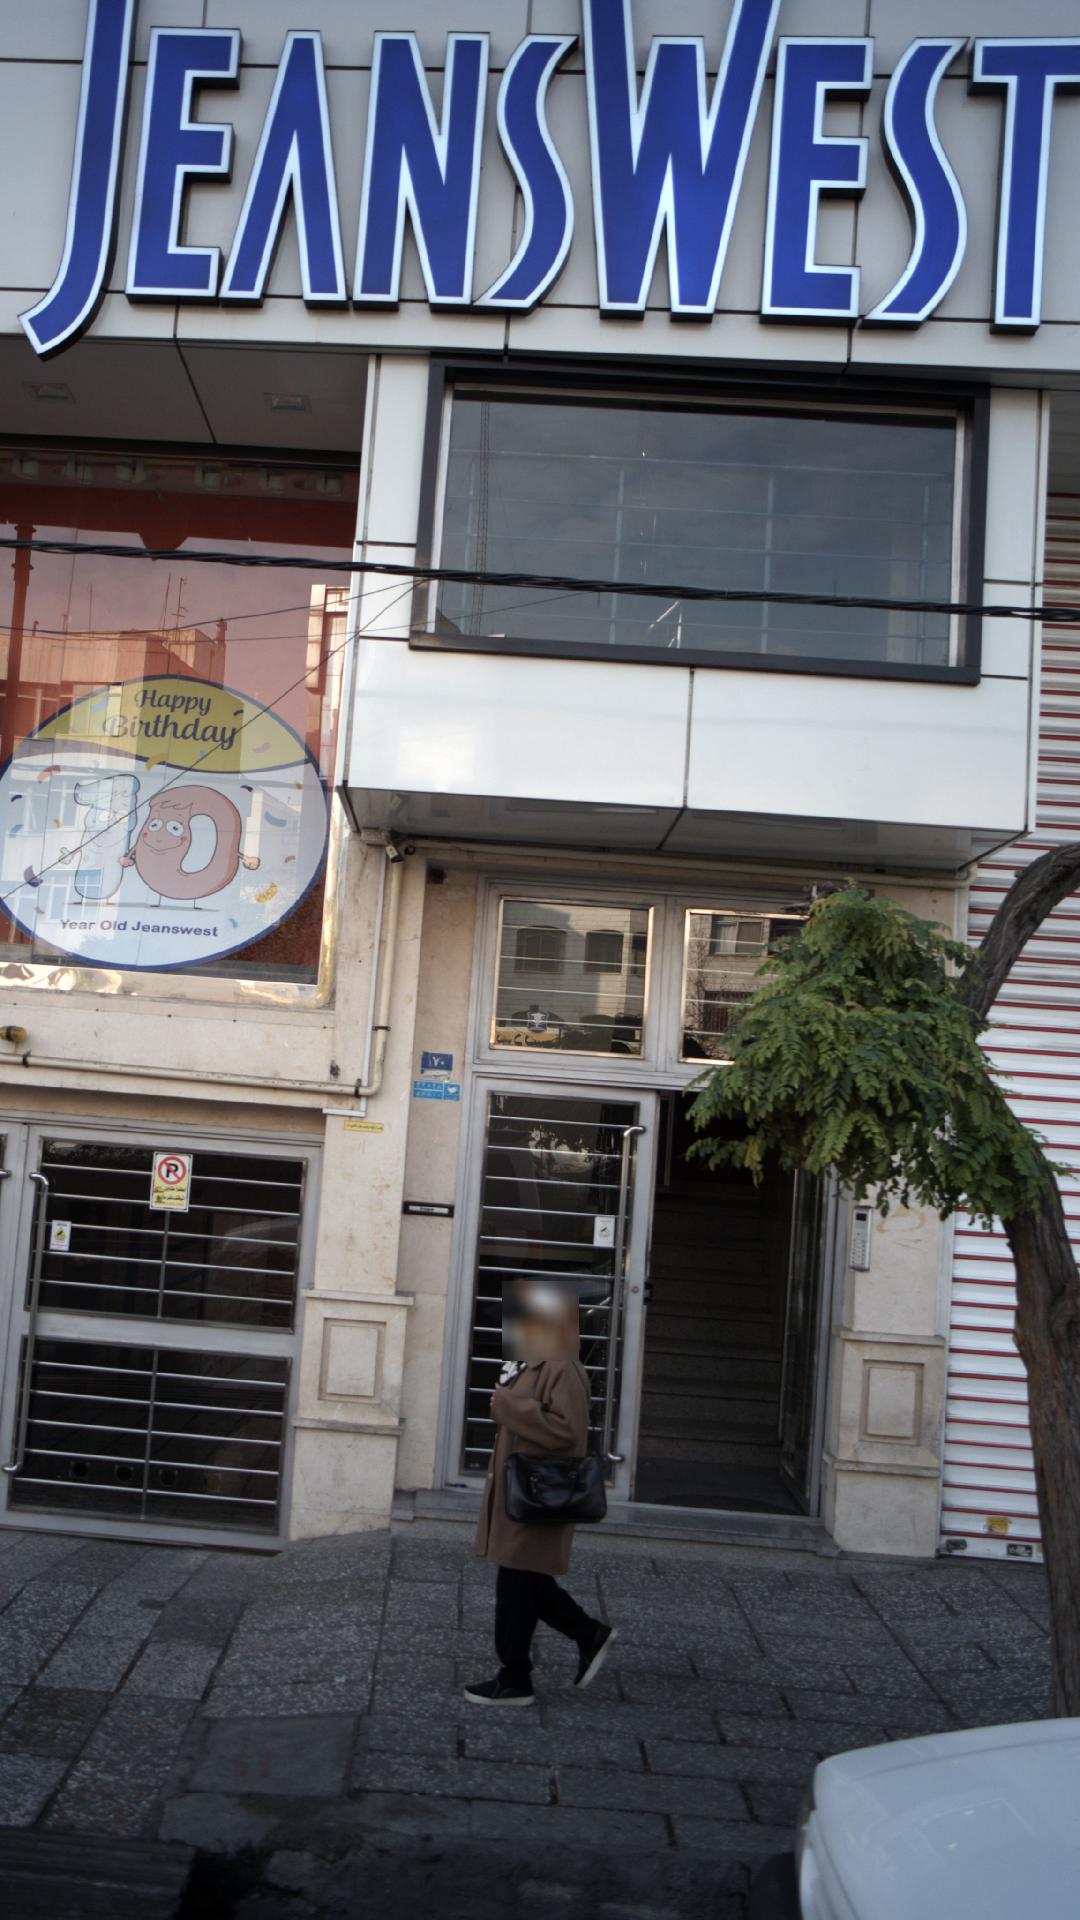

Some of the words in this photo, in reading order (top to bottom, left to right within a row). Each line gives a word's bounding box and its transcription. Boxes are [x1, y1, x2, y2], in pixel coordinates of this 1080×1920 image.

[18, 0, 1080, 357] JEANSWEST
[135, 689, 211, 716] Happy
[102, 714, 237, 750] Birthday
[60, 919, 96, 930] Year
[100, 920, 128, 931] Old
[131, 921, 219, 937] Jeanswest
